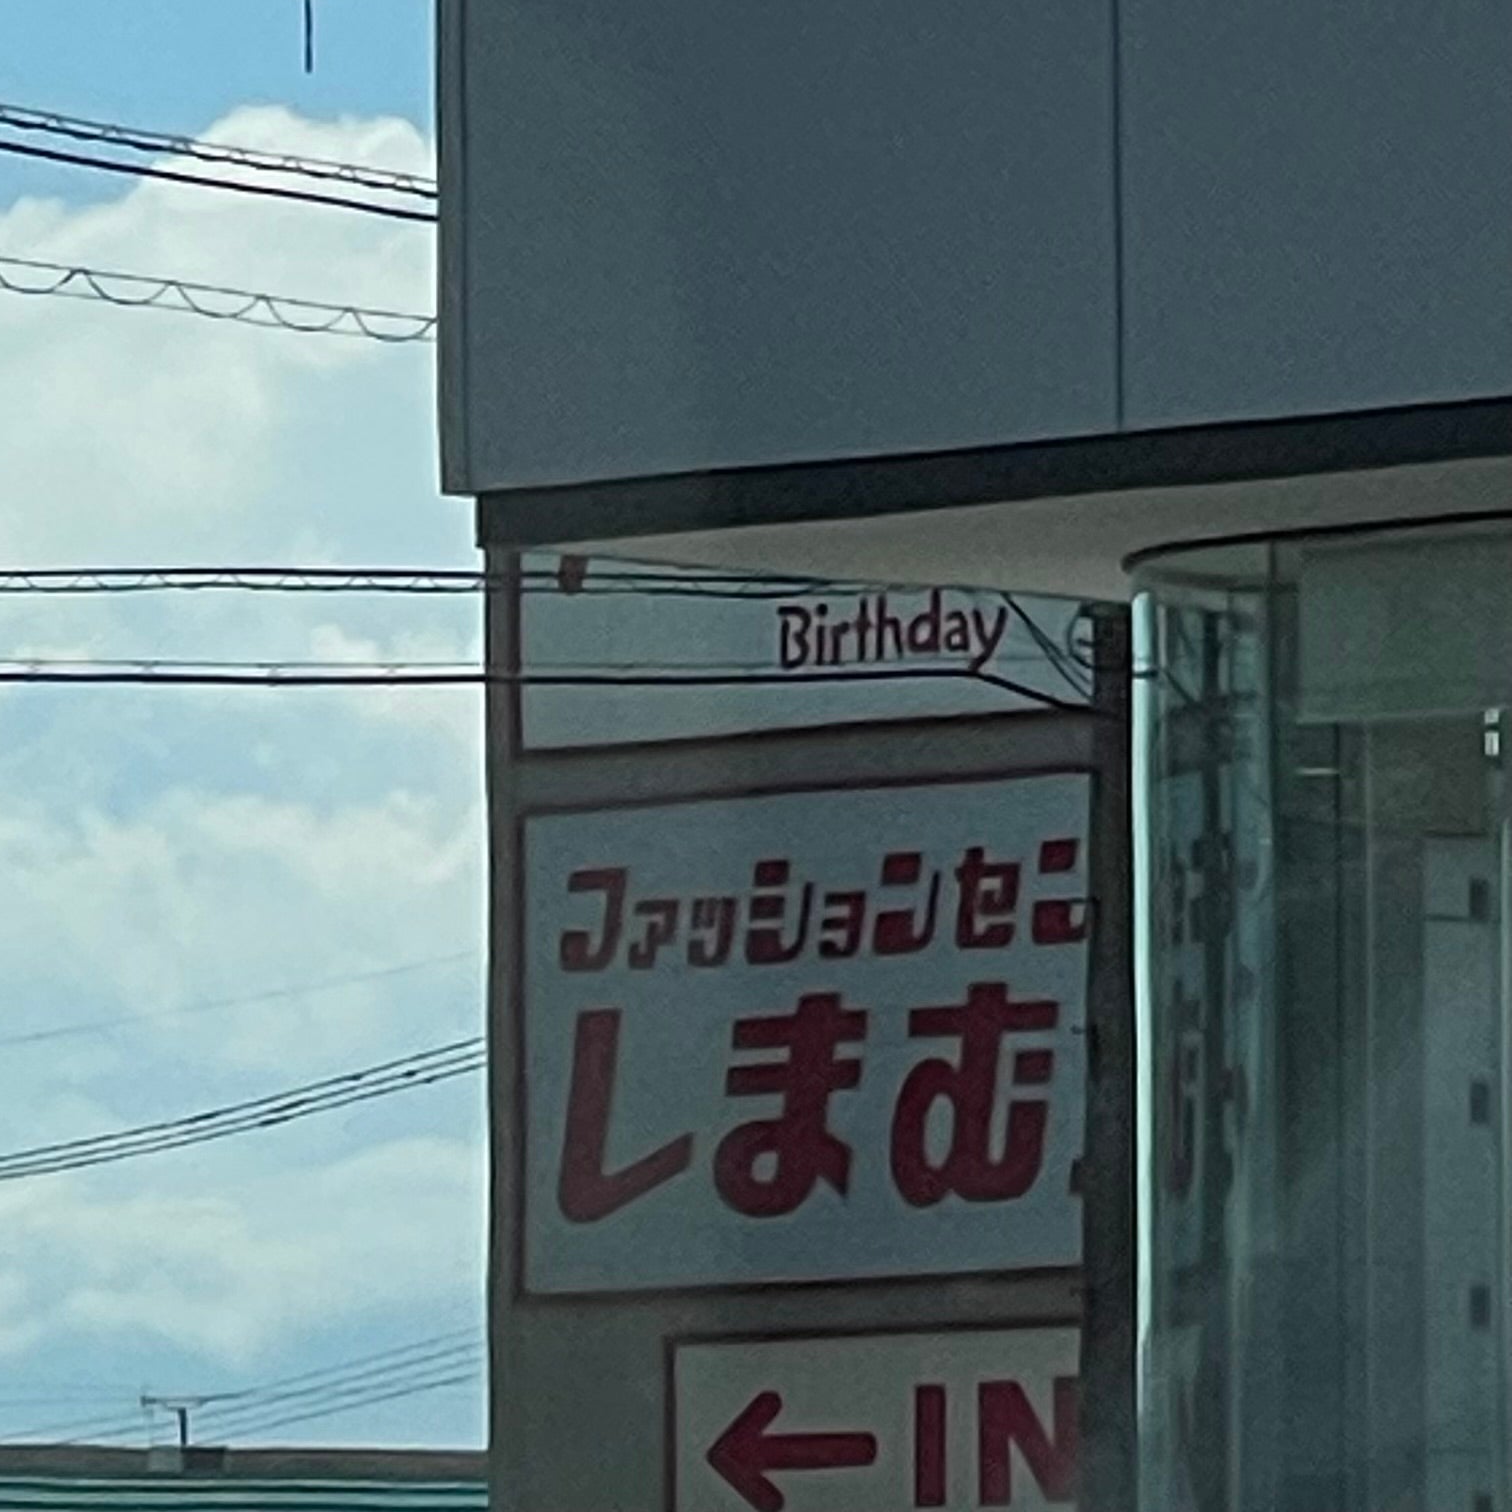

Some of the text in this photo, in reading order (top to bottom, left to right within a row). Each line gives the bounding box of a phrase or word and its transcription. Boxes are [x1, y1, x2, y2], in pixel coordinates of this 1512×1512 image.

[776, 587, 1008, 673] Birthday
[557, 982, 1085, 1223] しまむ
[913, 1377, 1081, 1508] IN
